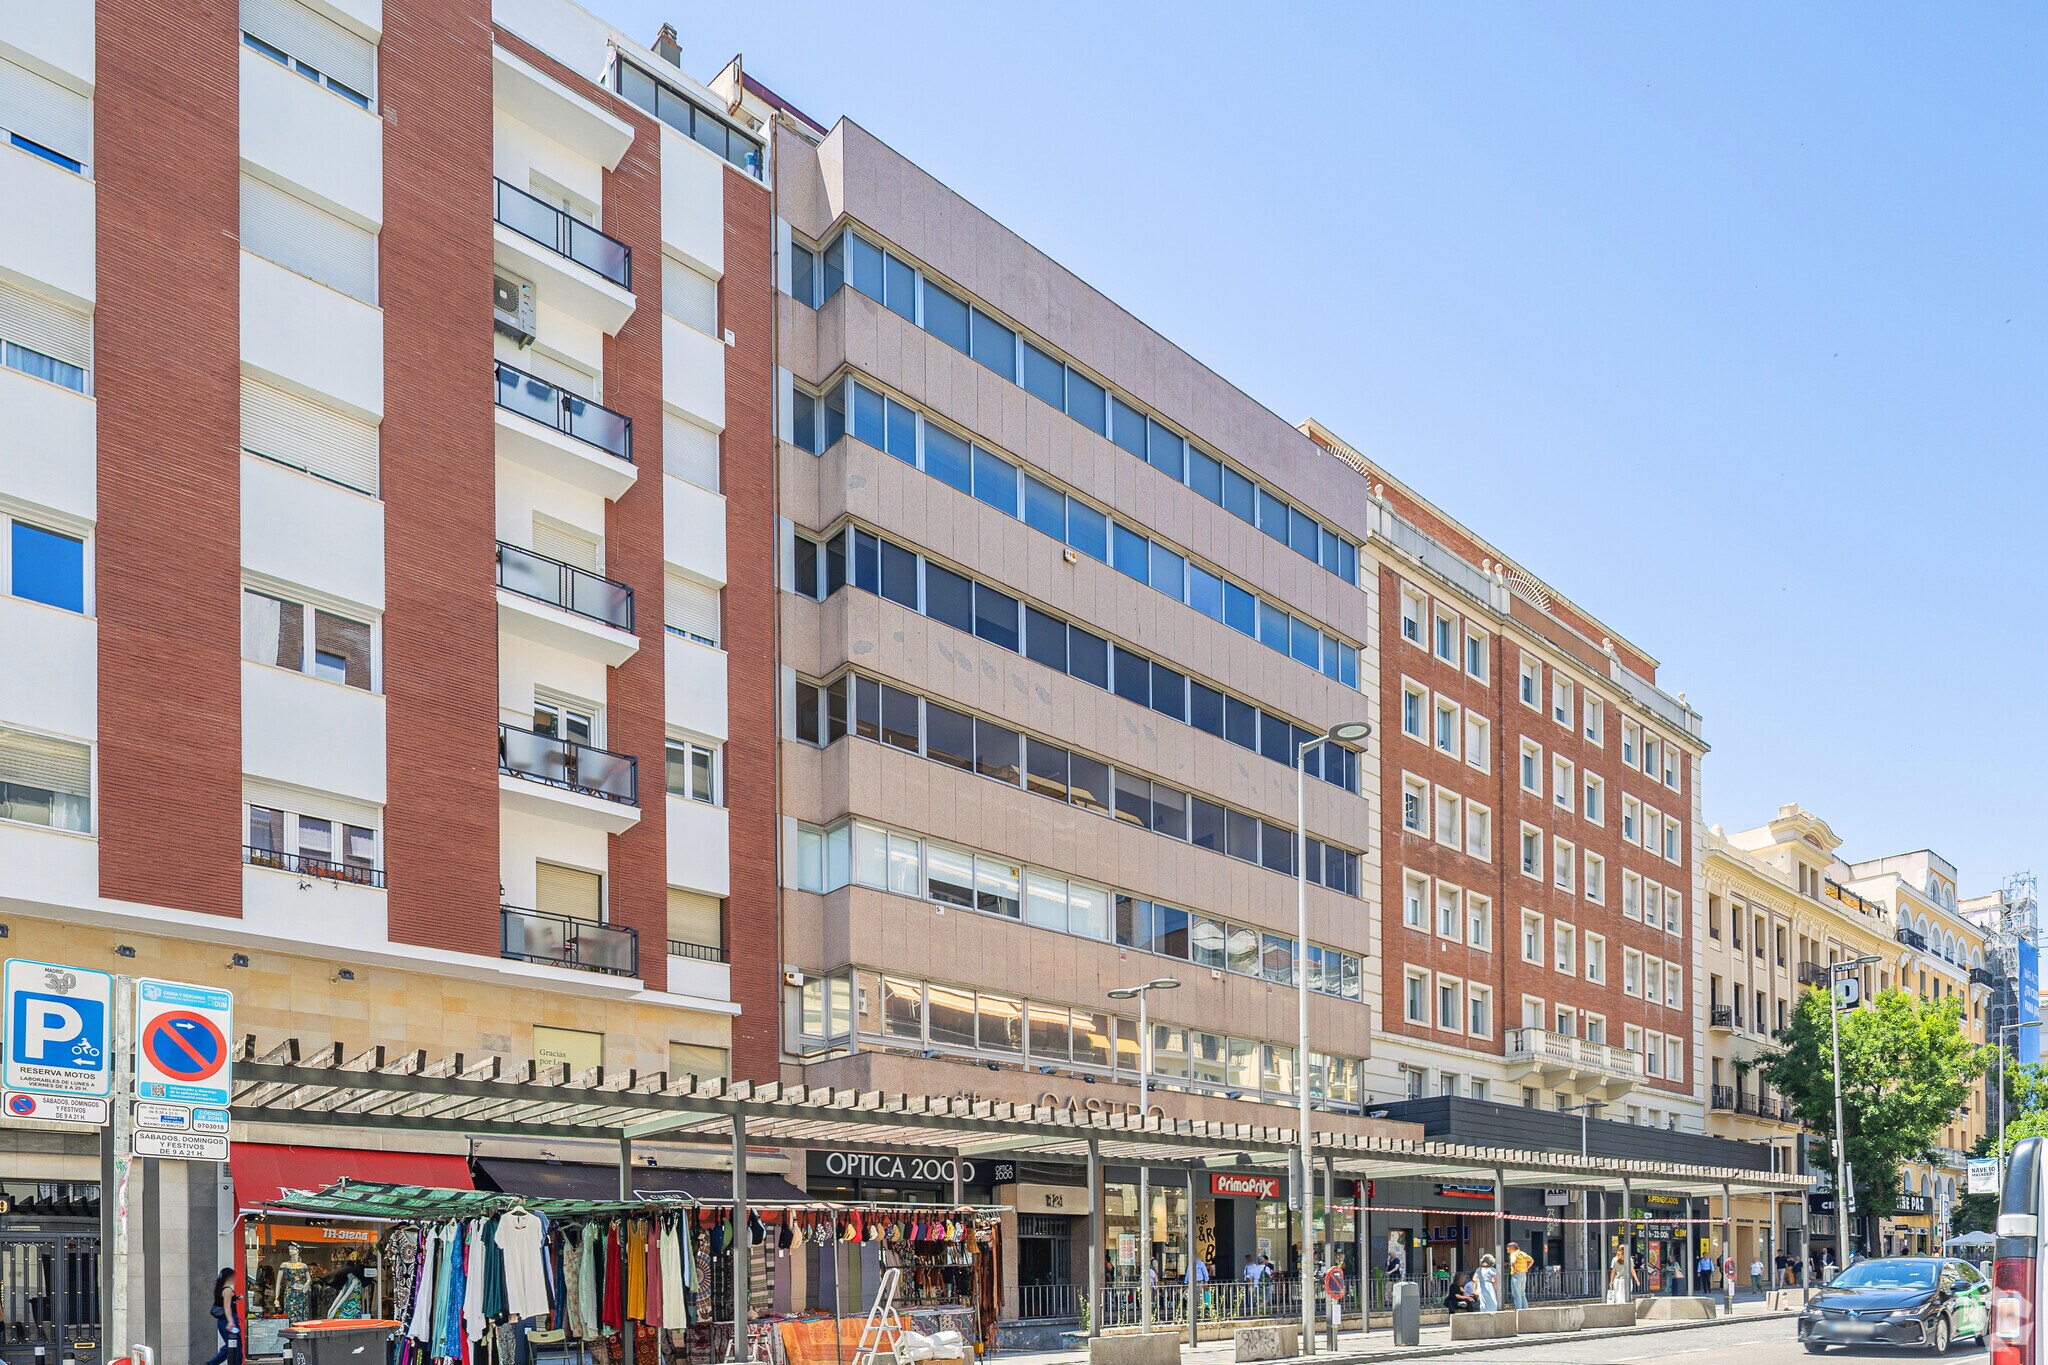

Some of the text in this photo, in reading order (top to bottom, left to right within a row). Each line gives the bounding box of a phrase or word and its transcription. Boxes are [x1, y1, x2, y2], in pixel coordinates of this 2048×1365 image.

[25, 998, 83, 1059] P
[539, 1049, 567, 1058] Gracias
[20, 1067, 96, 1080] RESERVA MOTOS
[20, 1076, 60, 1084] LABORABLES
[71, 1100, 99, 1108] DOMINGOS
[182, 1136, 224, 1145] DOMINGOS
[167, 1142, 205, 1150] FESTIVOS
[826, 1152, 976, 1182] OPTICA 2000
[995, 1164, 1013, 1173] OPTICA
[995, 1171, 1014, 1180] 2000
[1911, 1196, 1924, 1211] PAZ
[1422, 1226, 1470, 1241] ALDI
